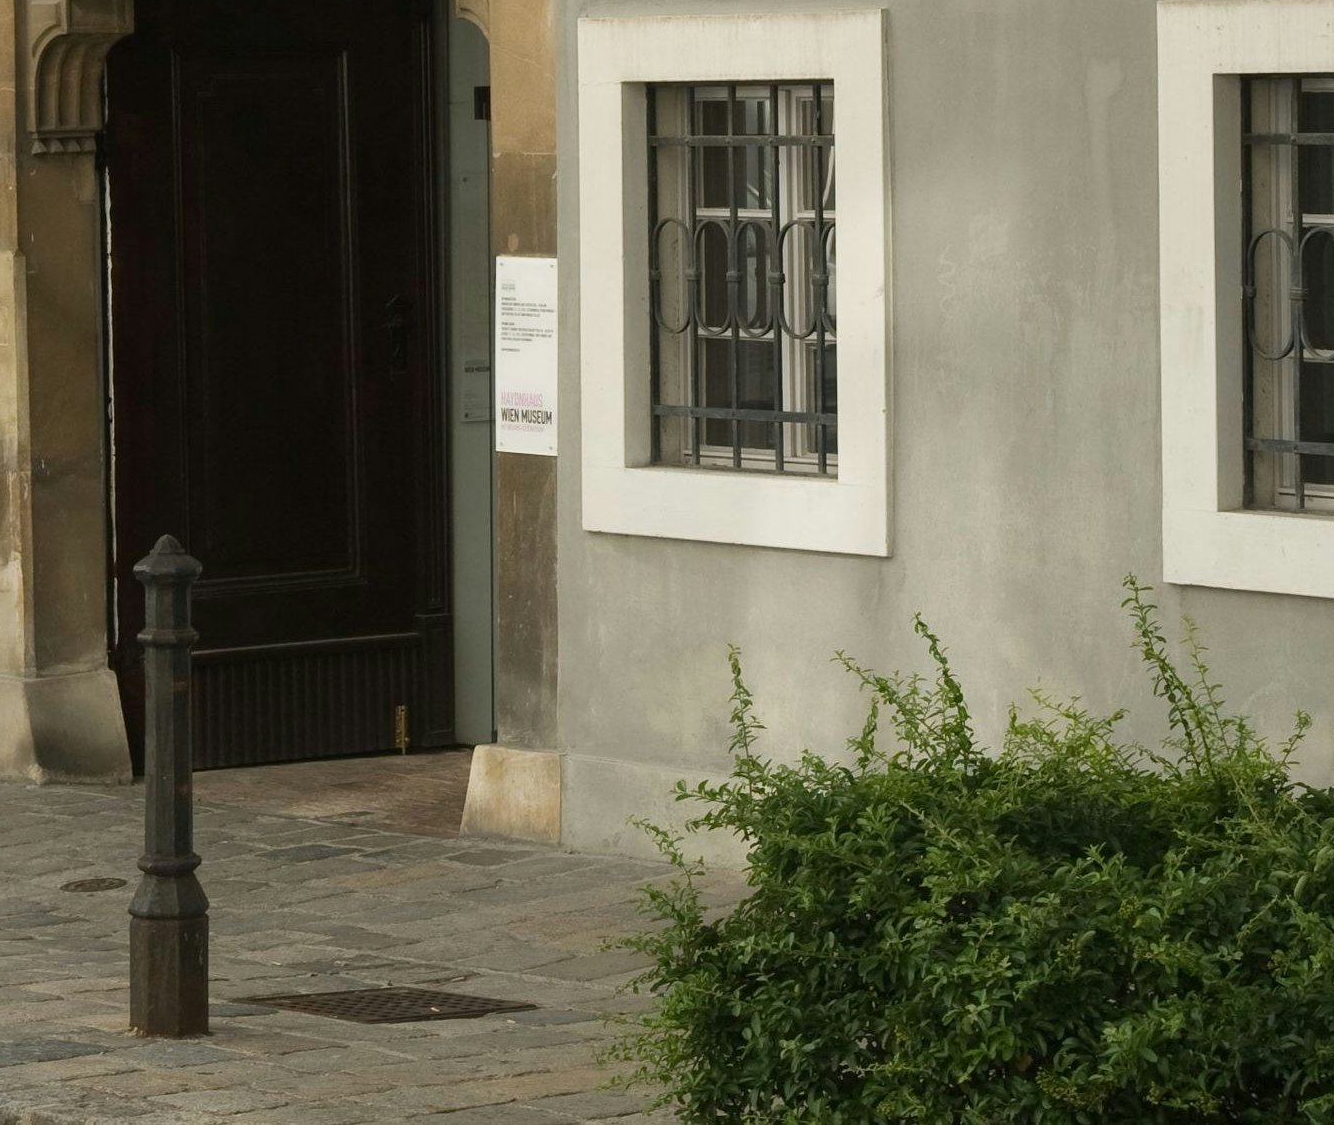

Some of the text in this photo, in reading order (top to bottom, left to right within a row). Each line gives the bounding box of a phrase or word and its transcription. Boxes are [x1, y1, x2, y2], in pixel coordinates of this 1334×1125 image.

[501, 391, 543, 408] HAYDNHAUS
[501, 407, 552, 425] WIEN MUSEUM
